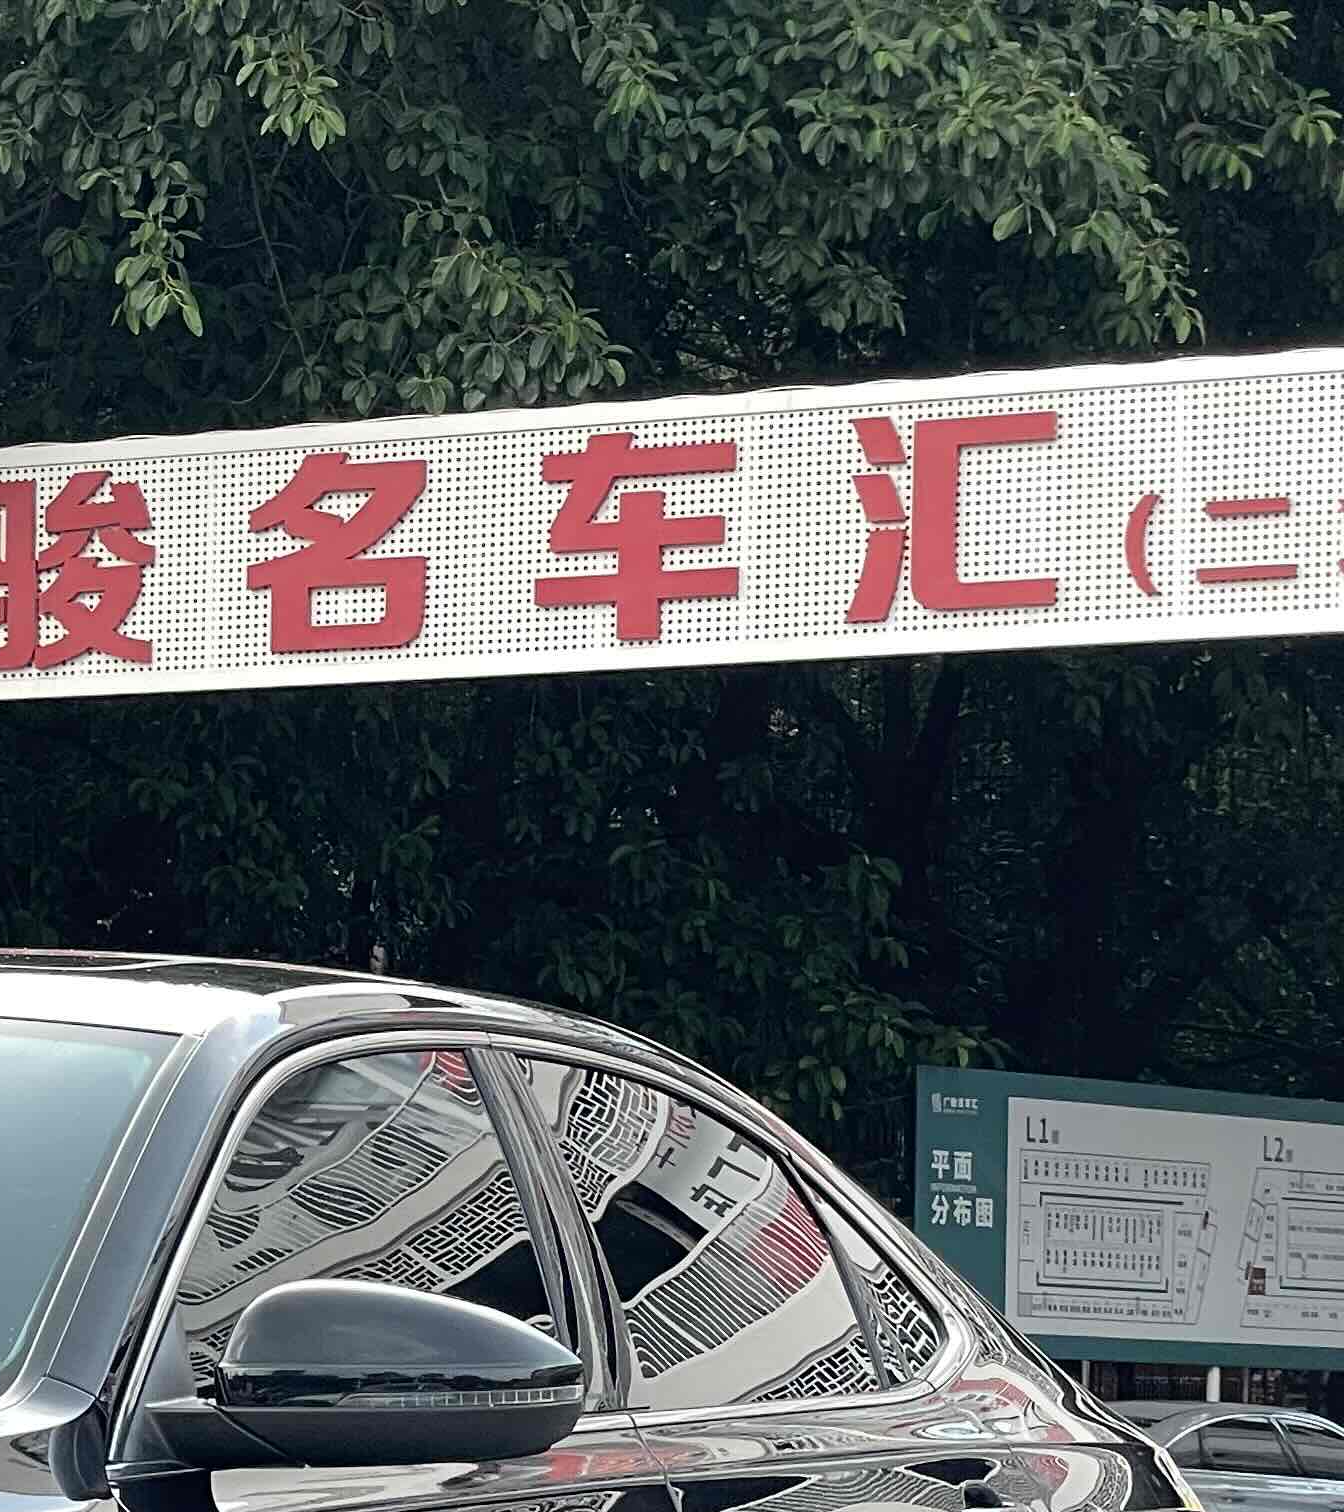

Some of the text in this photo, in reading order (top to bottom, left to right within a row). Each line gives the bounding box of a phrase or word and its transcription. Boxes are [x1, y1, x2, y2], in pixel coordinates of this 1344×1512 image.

[931, 1150, 973, 1182] 平面
[931, 1194, 994, 1229] 分布图
